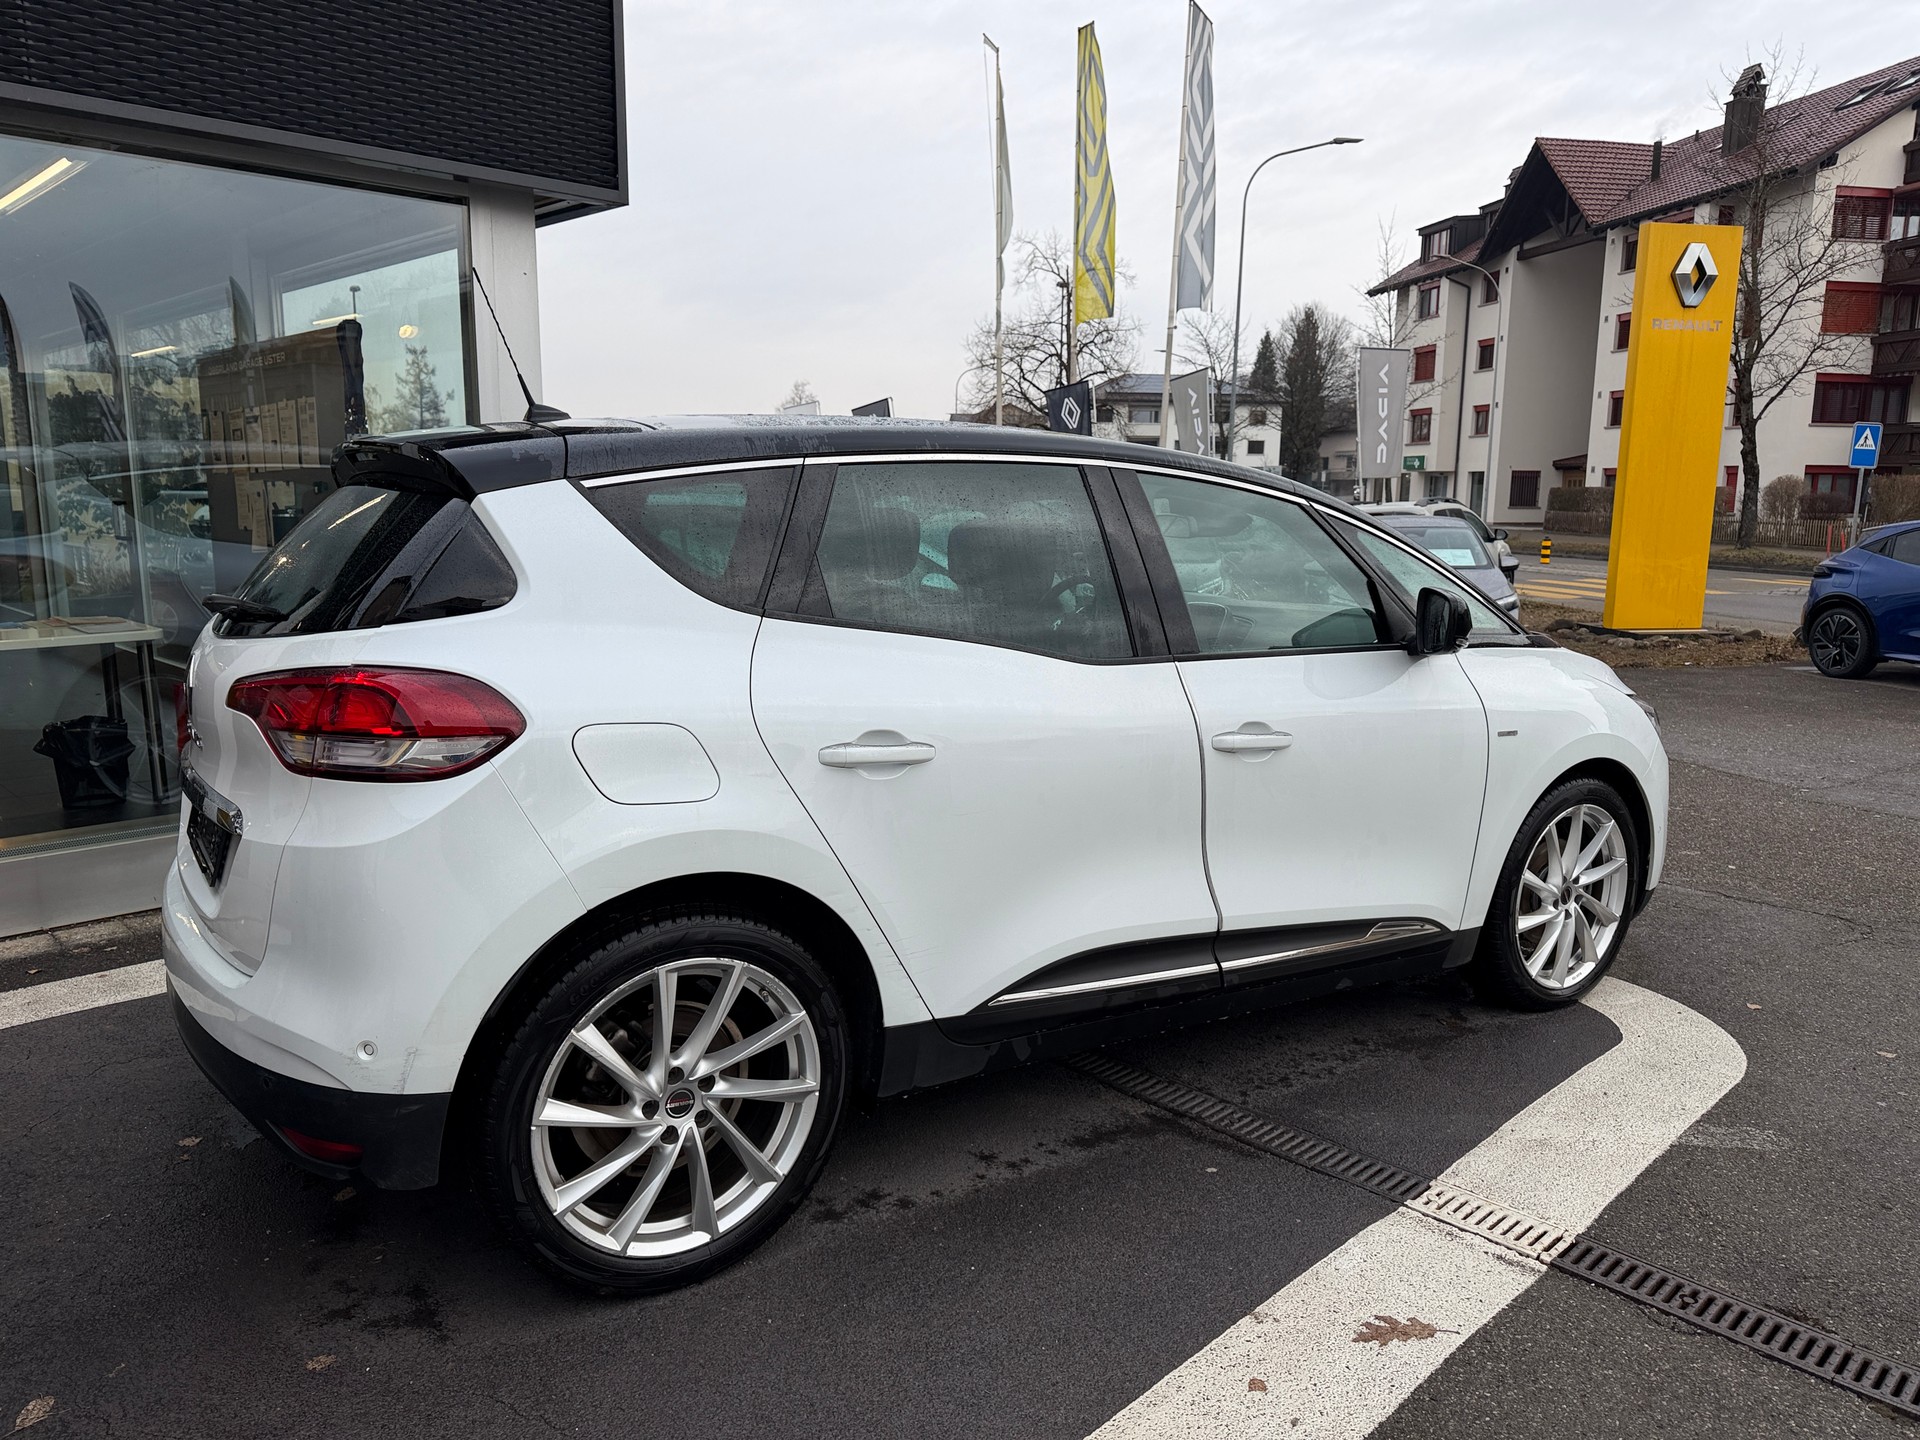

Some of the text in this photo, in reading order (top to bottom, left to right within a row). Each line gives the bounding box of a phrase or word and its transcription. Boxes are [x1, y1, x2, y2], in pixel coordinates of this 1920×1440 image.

[1651, 318, 1723, 332] RENAULT
[264, 351, 286, 365] USTER
[1376, 362, 1389, 464] DACIA
